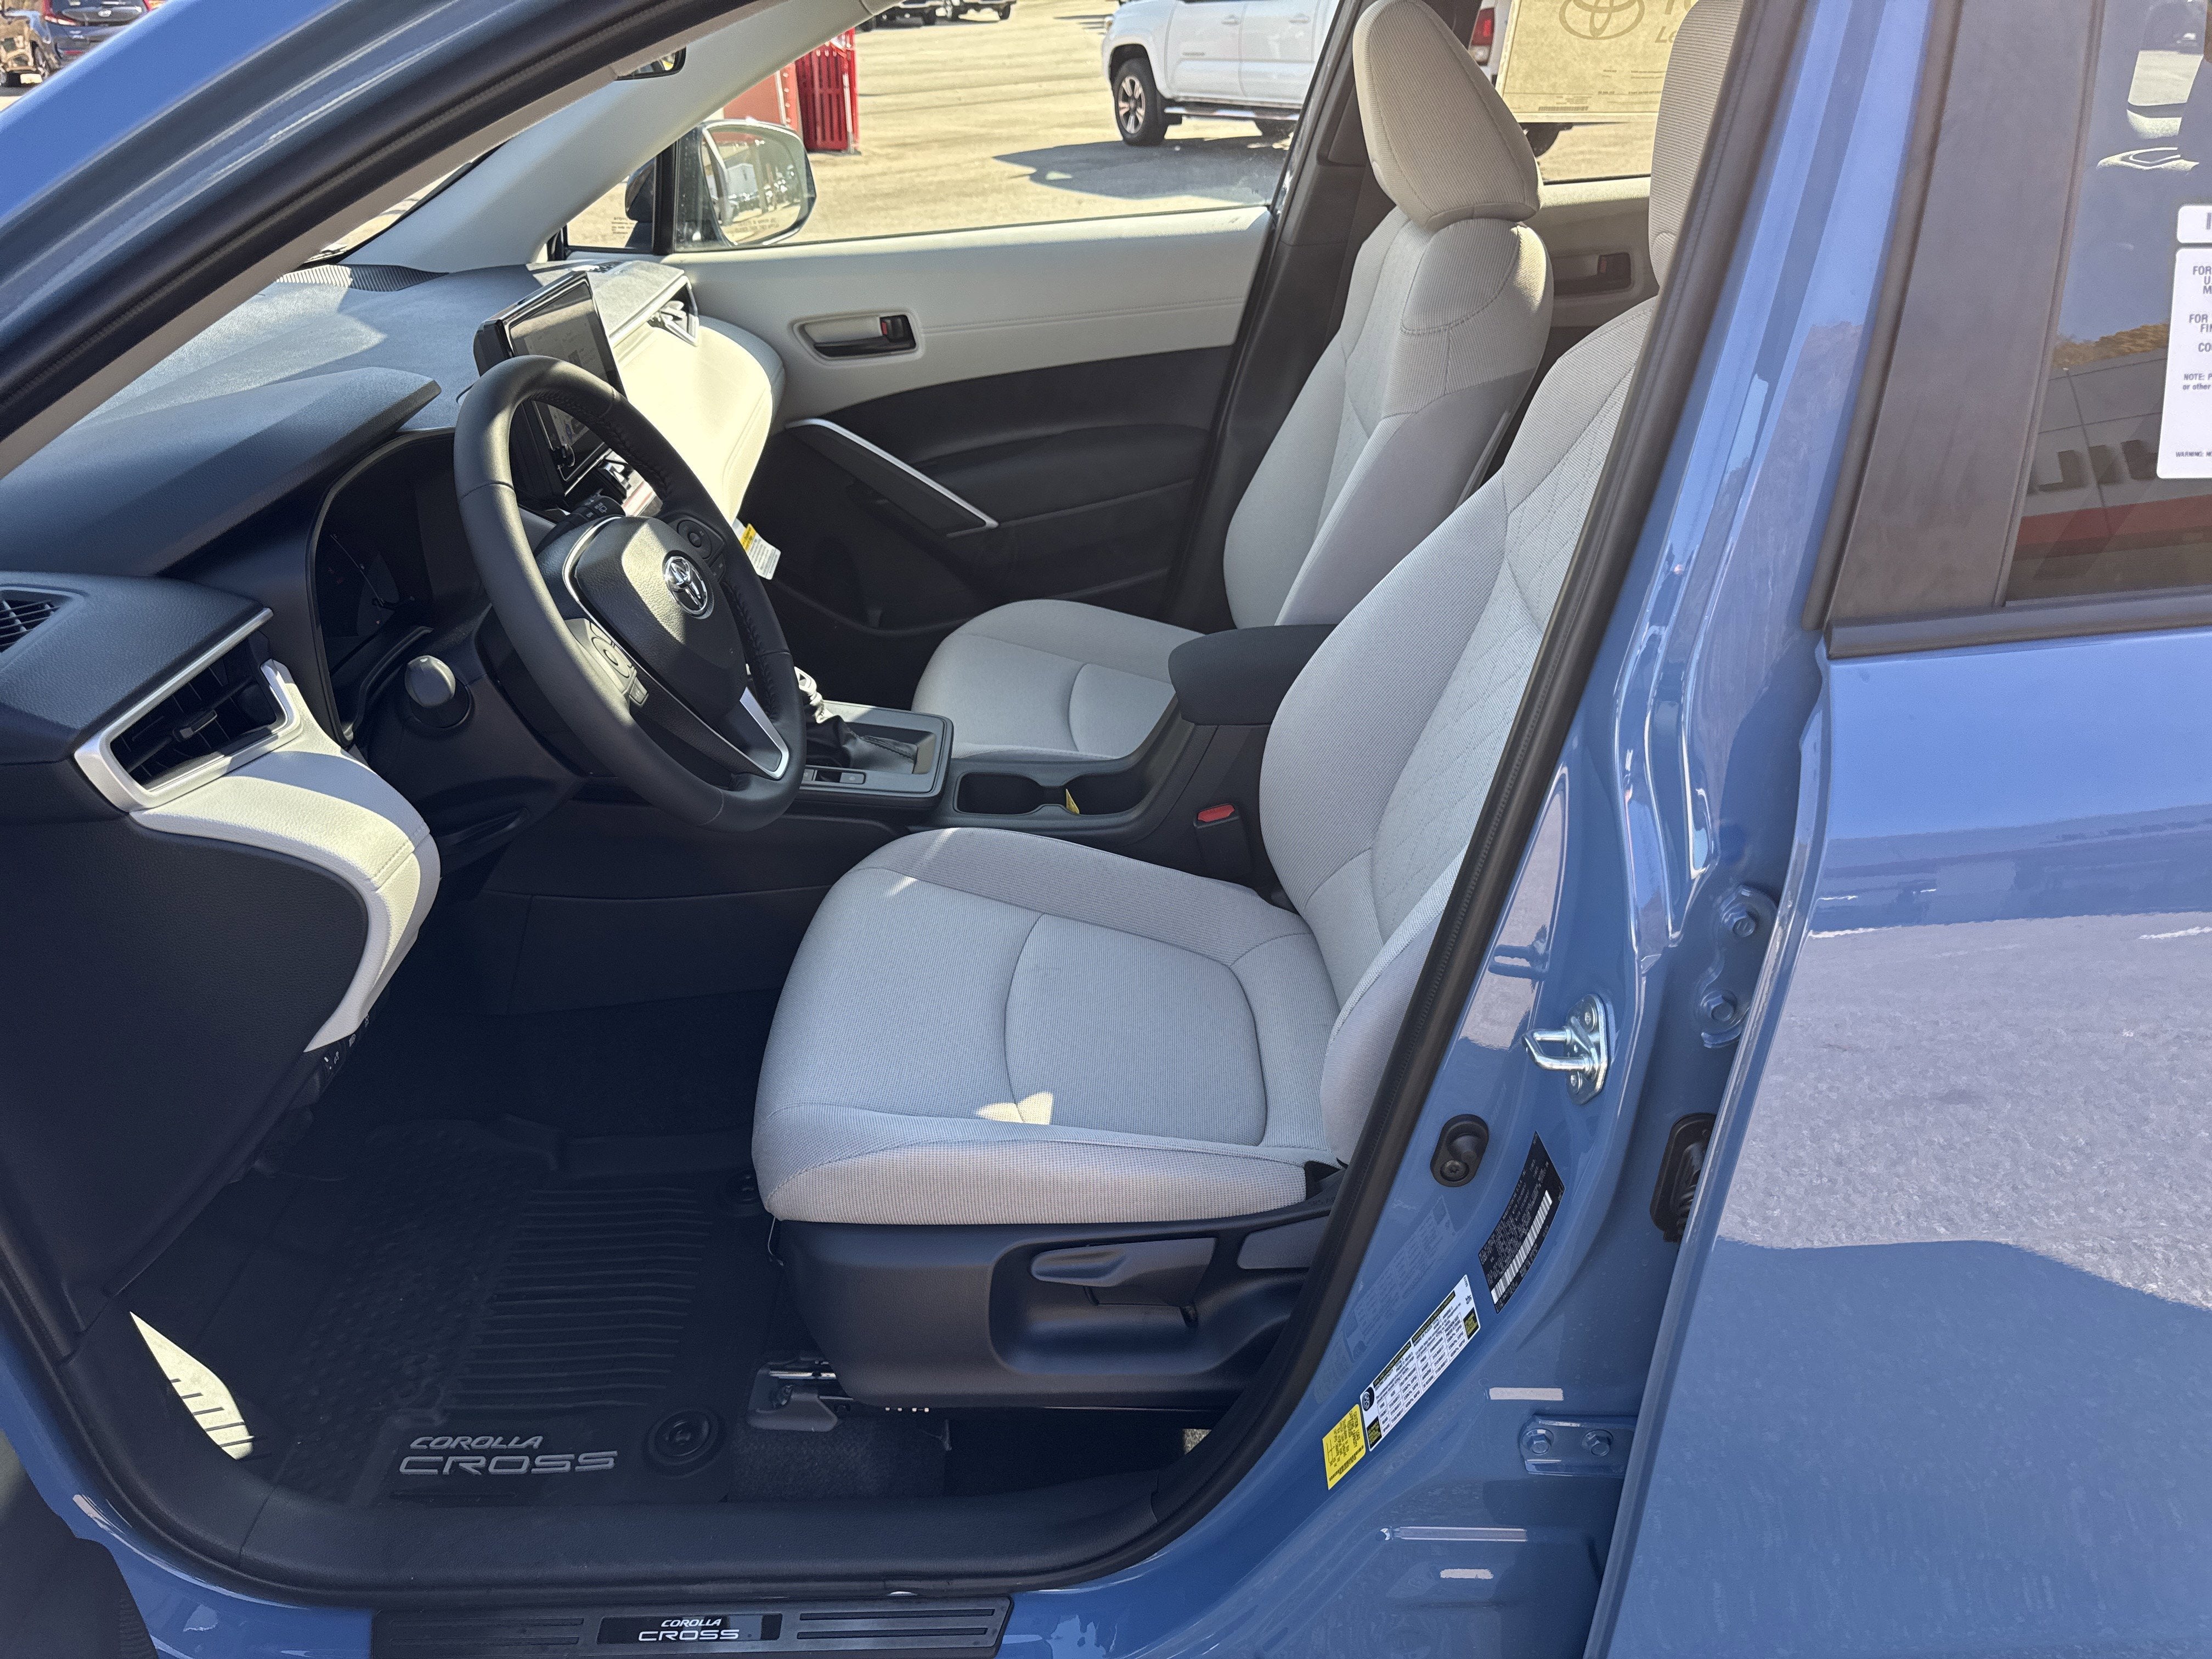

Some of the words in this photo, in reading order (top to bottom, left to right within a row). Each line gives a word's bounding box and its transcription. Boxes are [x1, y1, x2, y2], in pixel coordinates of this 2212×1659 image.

[2193, 266, 2212, 275] FOR
[2189, 314, 2208, 323] FOR
[2198, 342, 2212, 352] CO
[410, 1436, 543, 1451] COROLLA
[399, 1451, 618, 1475] CROSS
[661, 1618, 722, 1627] COROLLA
[639, 1629, 740, 1641] CROSS
